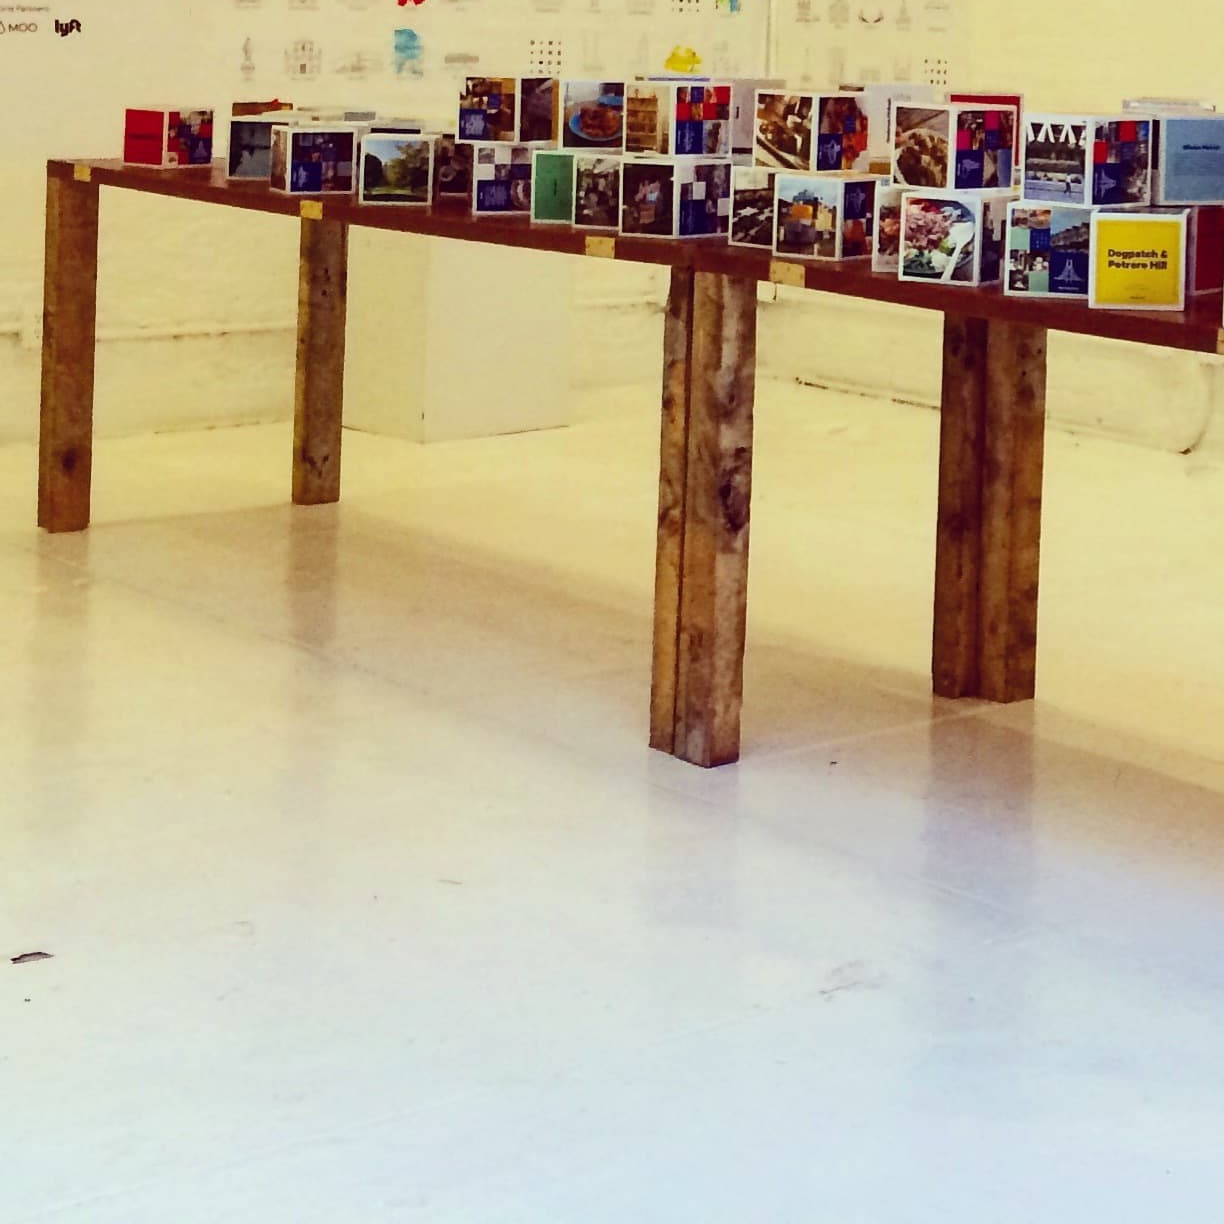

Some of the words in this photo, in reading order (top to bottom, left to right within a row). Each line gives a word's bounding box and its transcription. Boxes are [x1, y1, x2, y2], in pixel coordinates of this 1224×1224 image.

[8, 23, 38, 33] MOO
[55, 19, 81, 37] lyft
[1108, 249, 1158, 259] Dogpatch
[1160, 250, 1168, 258] &
[1150, 261, 1167, 270] Hill
